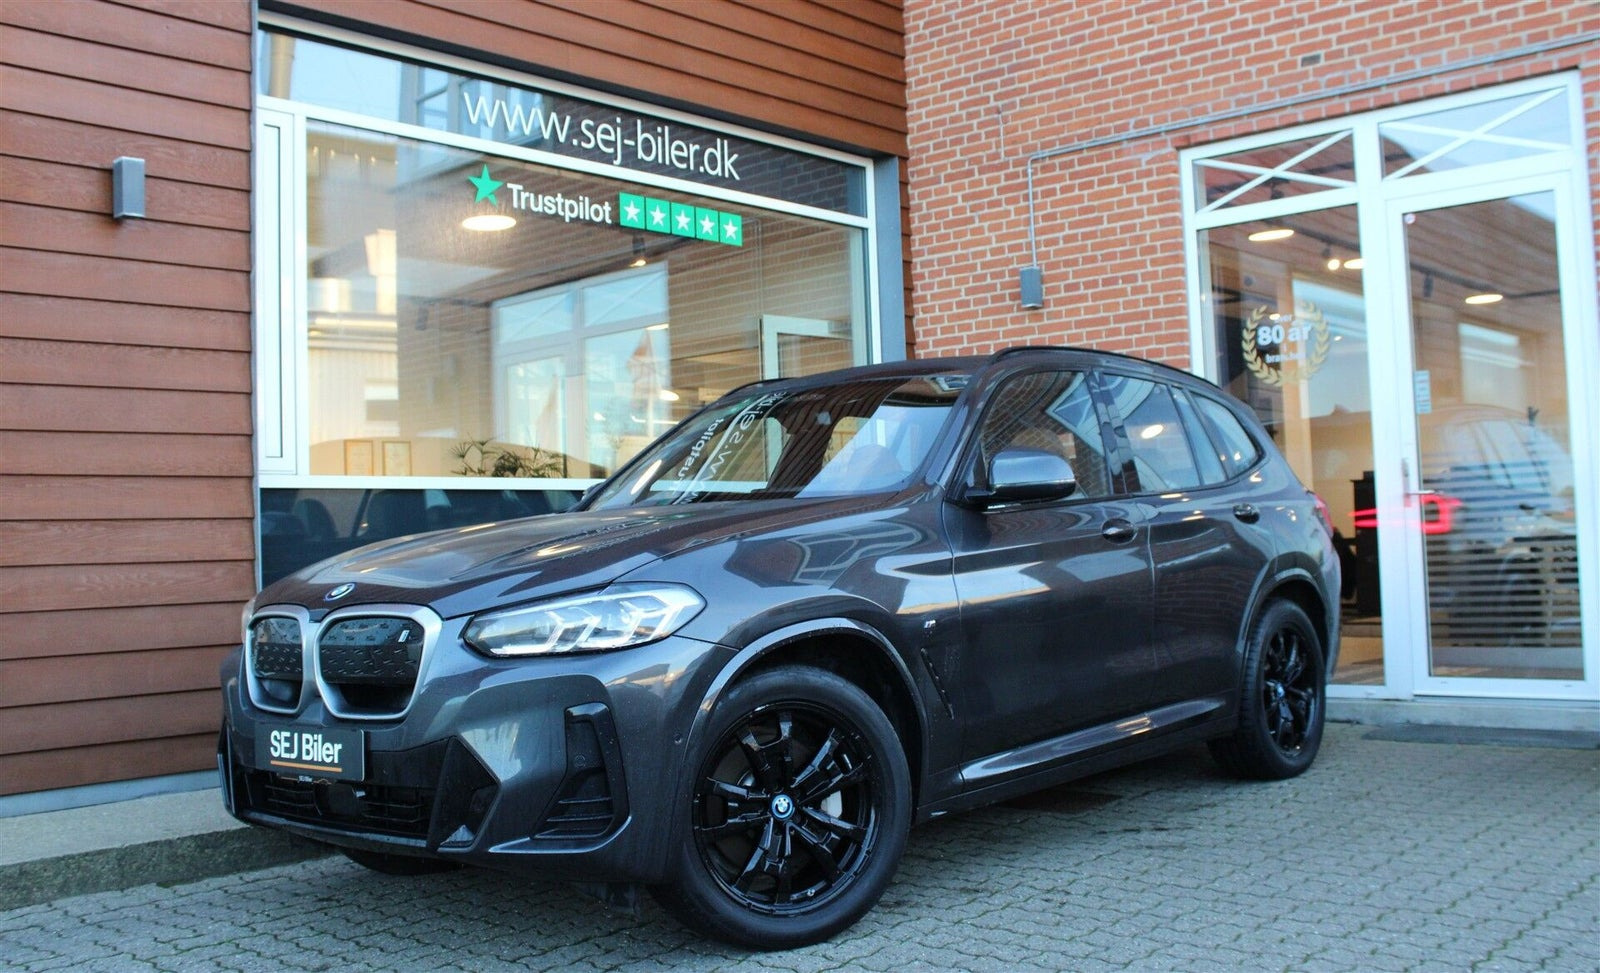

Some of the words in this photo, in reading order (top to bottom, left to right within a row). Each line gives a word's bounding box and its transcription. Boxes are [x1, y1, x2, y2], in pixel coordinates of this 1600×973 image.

[464, 92, 740, 180] www.sej-biler.dk
[507, 183, 612, 224] Trustpilot
[1257, 324, 1285, 346] 80
[270, 730, 298, 759] SEJ
[302, 733, 342, 763] Biler
